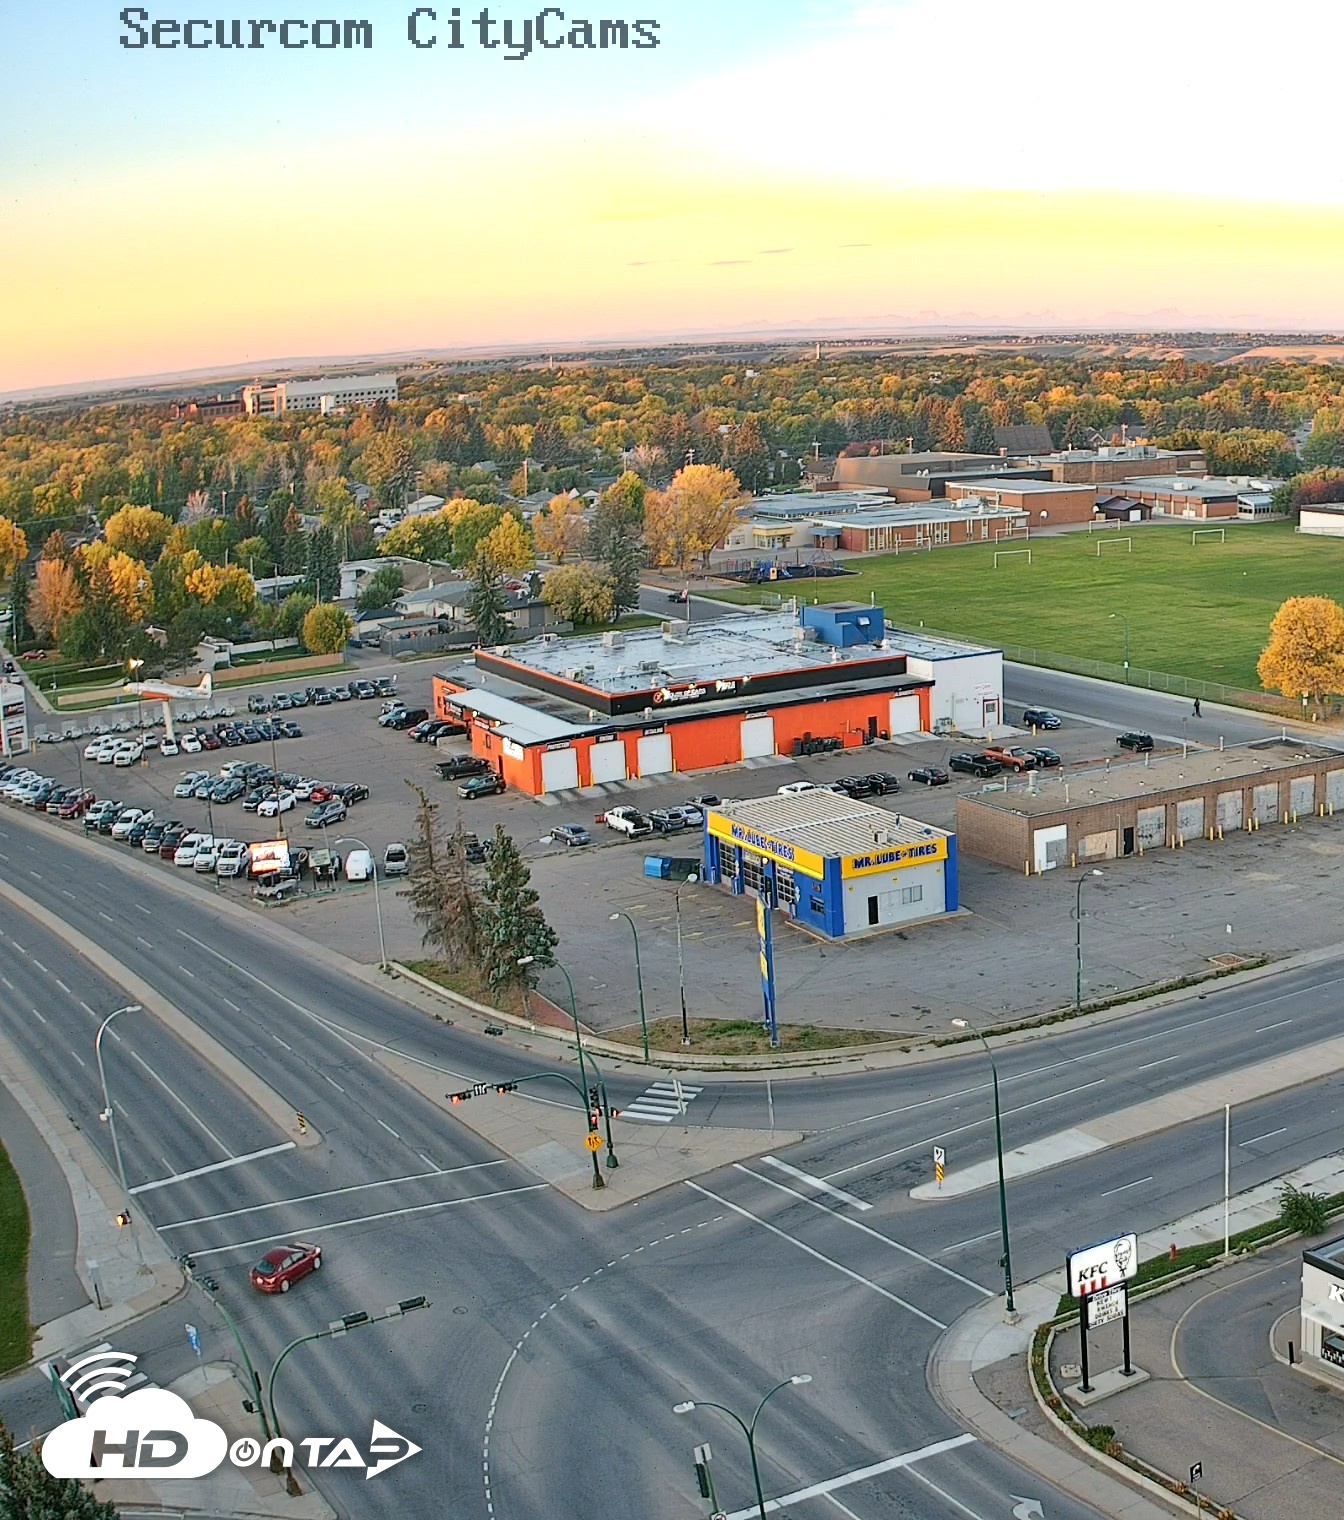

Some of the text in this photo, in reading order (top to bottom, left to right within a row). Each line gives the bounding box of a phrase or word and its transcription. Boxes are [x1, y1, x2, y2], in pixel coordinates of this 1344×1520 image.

[731, 823, 747, 841] MR.
[746, 829, 767, 851] LUBE
[772, 839, 795, 862] TIRES
[853, 856, 876, 870] MR.
[876, 849, 901, 864] LUBE
[908, 843, 938, 858] TIRES
[1078, 1261, 1108, 1283] KFC
